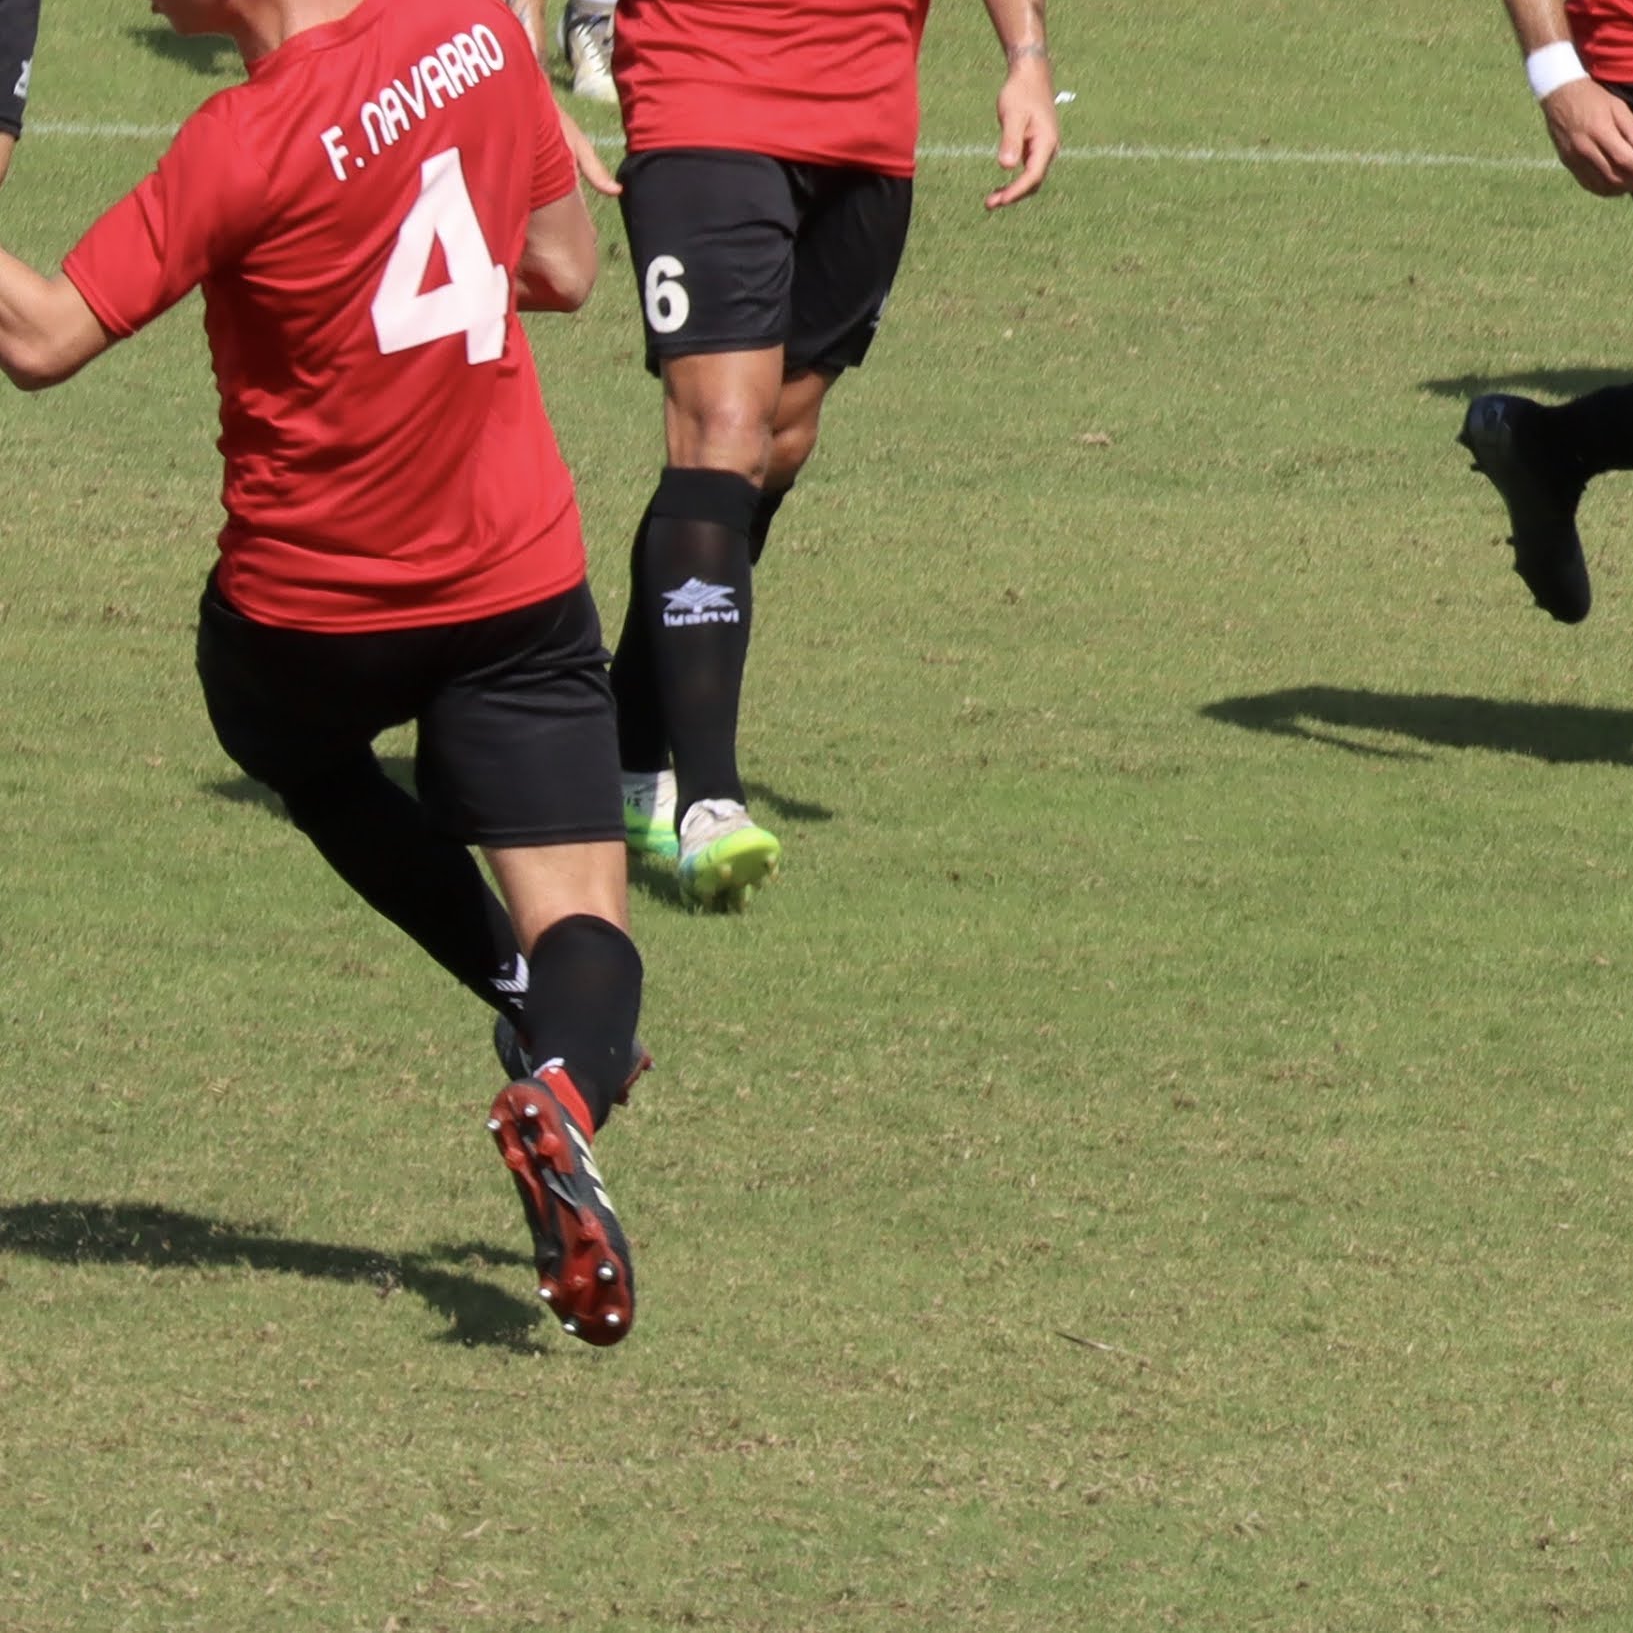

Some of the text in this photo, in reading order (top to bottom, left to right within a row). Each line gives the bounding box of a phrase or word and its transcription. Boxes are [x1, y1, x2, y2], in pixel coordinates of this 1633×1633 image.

[320, 23, 505, 181] F. NAVARRO
[371, 147, 509, 366] 4
[645, 254, 690, 334] 6
